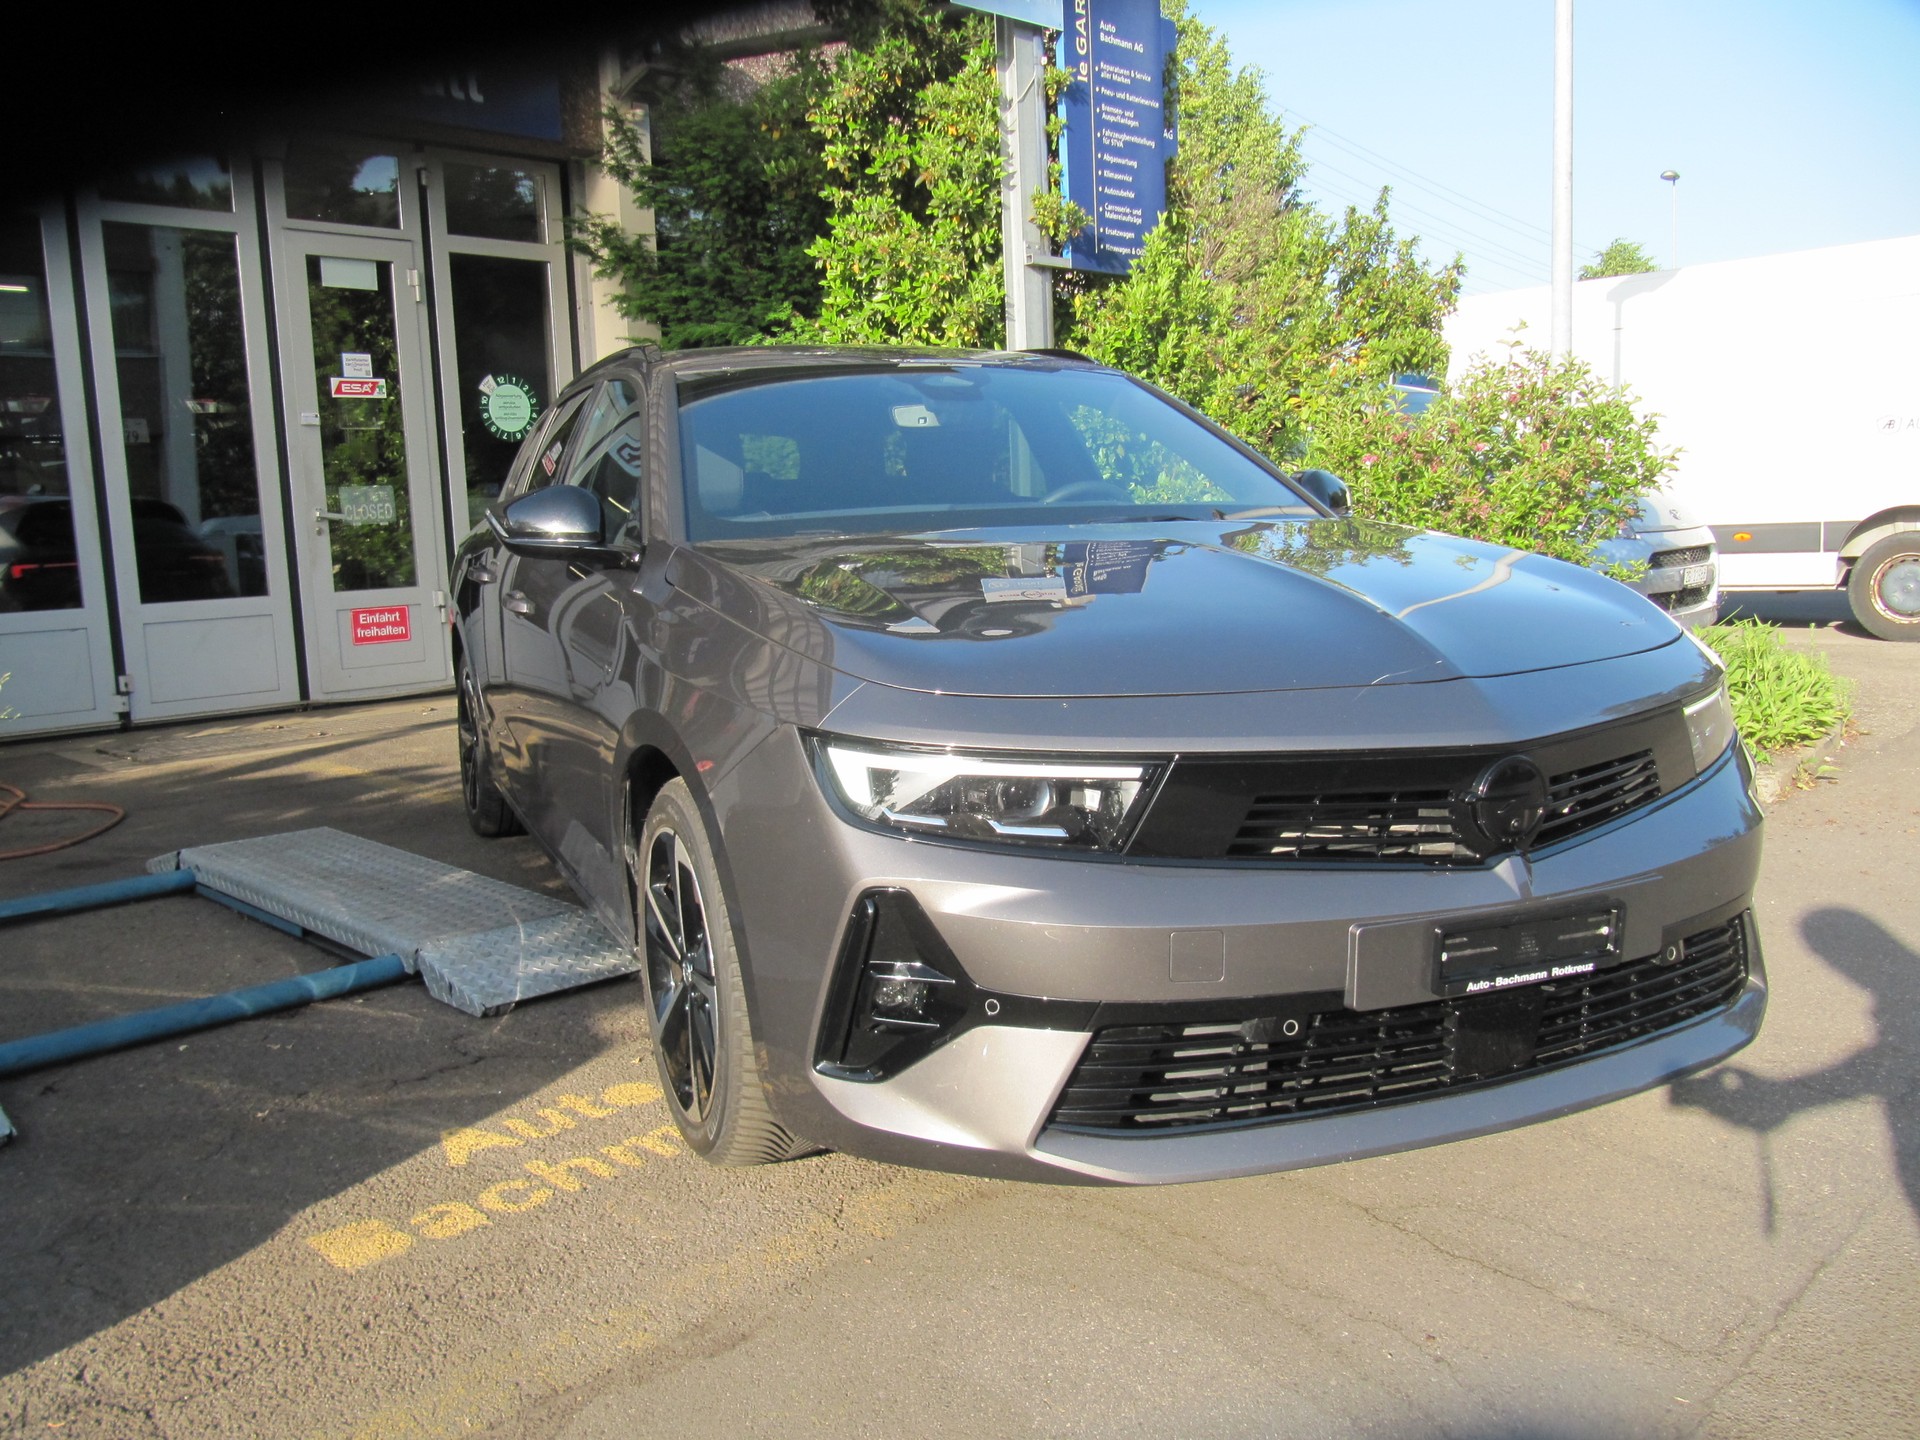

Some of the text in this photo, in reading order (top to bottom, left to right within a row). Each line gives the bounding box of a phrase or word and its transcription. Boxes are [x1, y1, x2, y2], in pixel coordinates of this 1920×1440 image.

[1100, 21, 1116, 33] Auto
[1100, 32, 1144, 53] Bachmann AG
[1100, 62, 1130, 77] Reparaturen
[1135, 71, 1151, 82] Service
[1112, 73, 1131, 84] Marken
[1116, 90, 1126, 100] und
[1124, 109, 1134, 118] und
[1103, 169, 1133, 182] Klimaservice
[1132, 208, 1142, 216] und
[1105, 227, 1135, 239] Ersatzwagen
[344, 503, 393, 521] CLOSED
[359, 611, 401, 624] Einfahrt
[357, 625, 406, 638] freihalten
[1551, 962, 1595, 977] Rotkreuz
[441, 1081, 665, 1167] Auto
